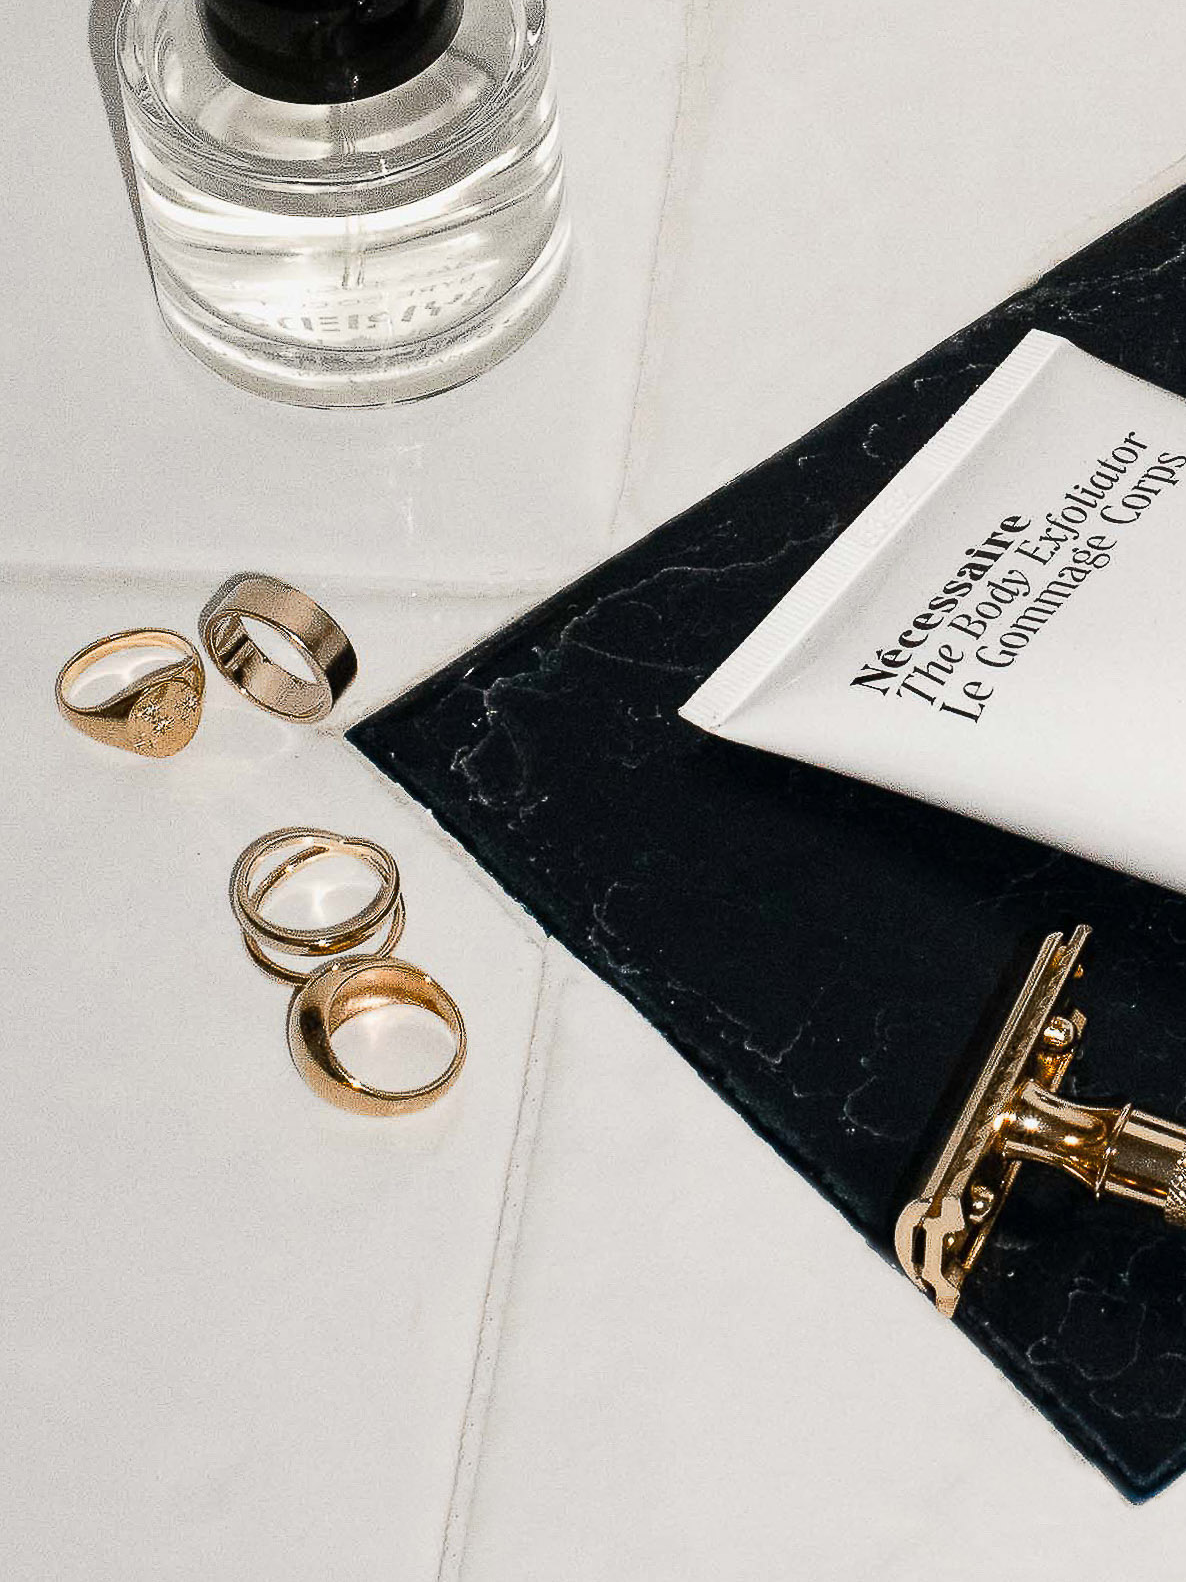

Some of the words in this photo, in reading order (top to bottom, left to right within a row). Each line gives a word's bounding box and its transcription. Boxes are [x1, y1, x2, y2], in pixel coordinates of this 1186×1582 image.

[850, 514, 1032, 697] Nécessaire
[896, 643, 965, 706] The
[947, 569, 1031, 641] Body
[1014, 431, 1151, 566] Exfoliator
[938, 680, 994, 724] Le
[975, 534, 1118, 668] Gommage
